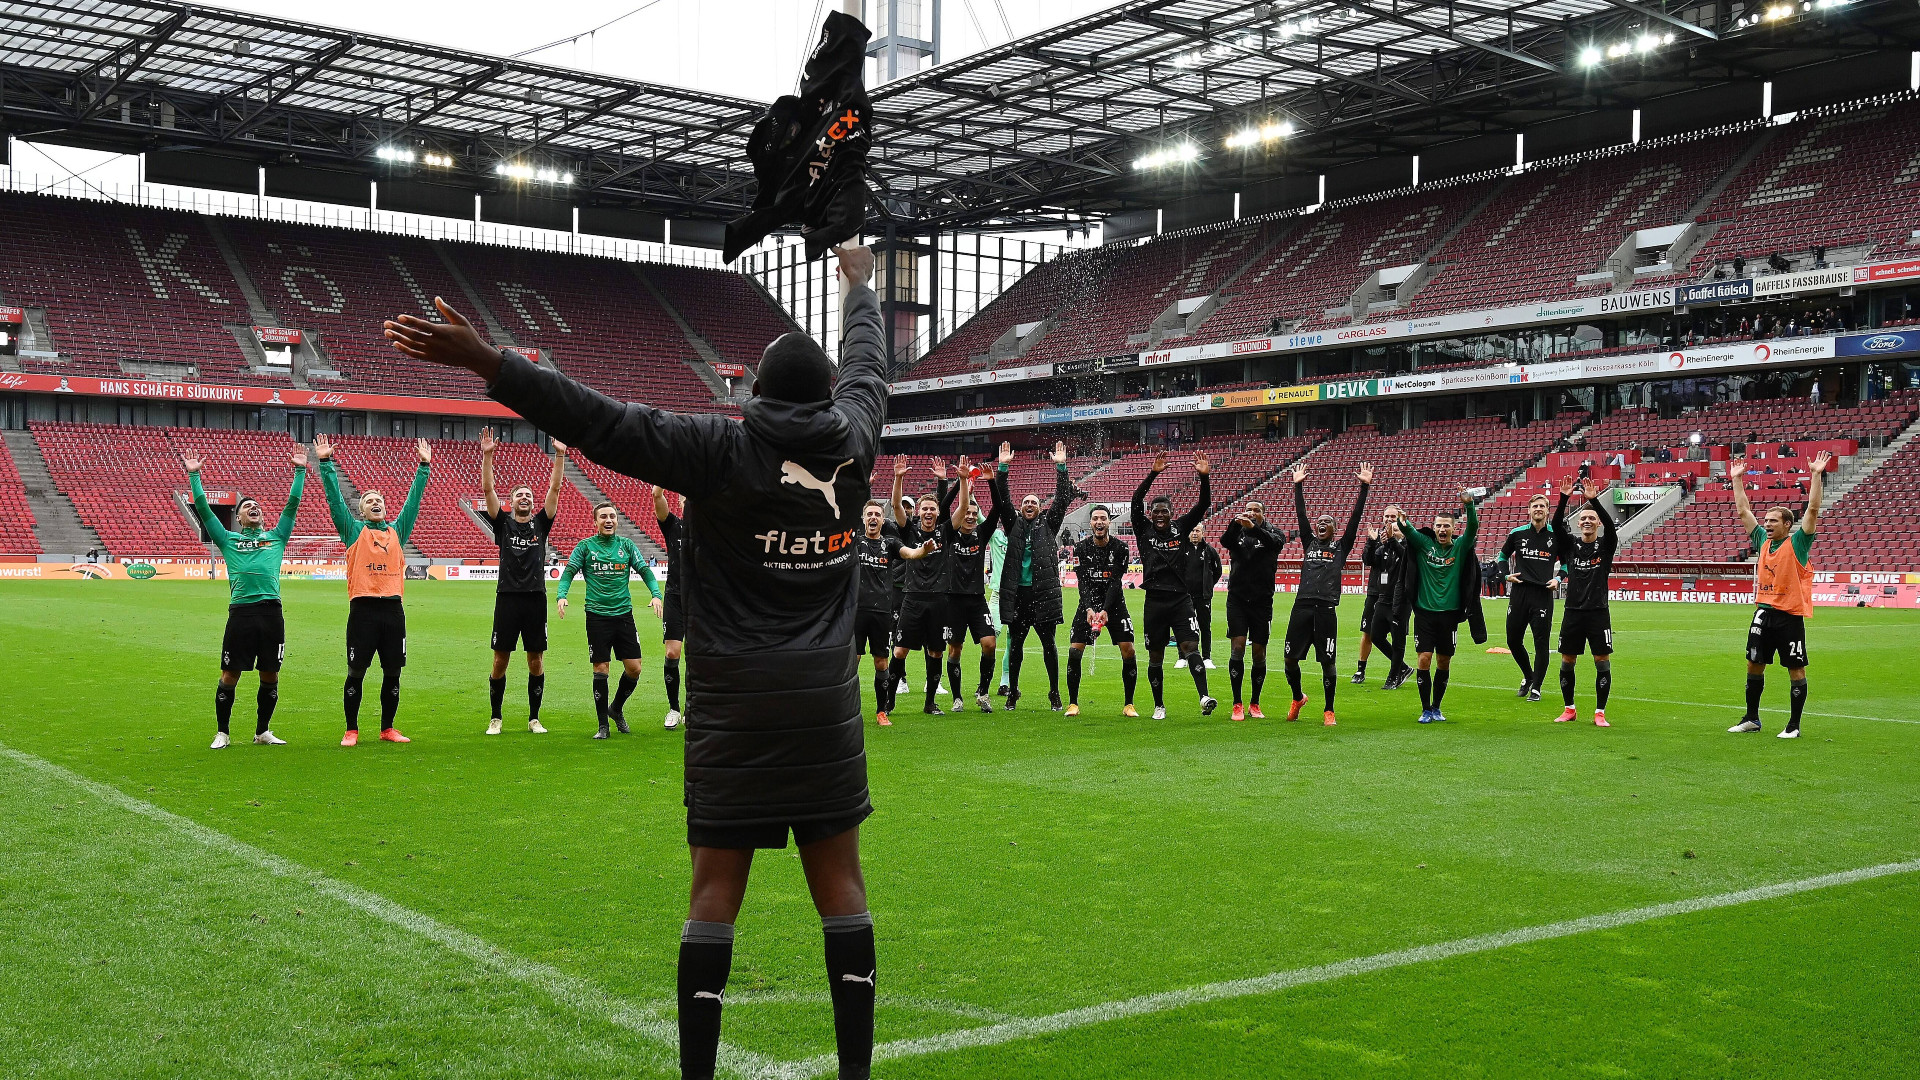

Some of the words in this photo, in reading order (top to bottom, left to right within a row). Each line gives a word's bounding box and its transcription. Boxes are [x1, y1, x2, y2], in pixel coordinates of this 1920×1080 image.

[811, 28, 830, 60] sonepar
[1755, 278, 1790, 292] GAFFELS
[1792, 271, 1848, 288] FASSBRAUSE
[1688, 285, 1716, 300] Gaffel
[1718, 282, 1749, 298] Kölsch
[1601, 290, 1671, 312] BAUWENS
[1337, 327, 1387, 340] CARGLASS
[1233, 340, 1268, 353] REMONDIS
[1289, 334, 1322, 347] stewe
[1870, 337, 1897, 349] Ford
[1773, 345, 1825, 356] RheinEnergie
[1686, 352, 1735, 364] RheinEnergie
[1585, 362, 1637, 373] Kreissparkasse
[1638, 360, 1654, 369] Köln
[1395, 378, 1436, 389] NetCologne
[1441, 373, 1475, 385] Sparkasse
[100, 380, 129, 395] HANS
[133, 381, 184, 398] SCHÄFER
[187, 384, 244, 401] SÜDKURVE
[1278, 389, 1314, 400] RENAULT
[1326, 380, 1369, 399] DEVK
[1073, 407, 1114, 418] SIEGENIA
[1167, 401, 1200, 413] sunzinet
[0, 566, 42, 577] wurst!
[184, 567, 204, 577] Hol
[1342, 585, 1364, 595] REWE
[1608, 590, 1640, 601] REWE
[1644, 590, 1678, 602] REWE
[1681, 591, 1716, 603] REWE
[1720, 592, 1755, 604] REWE
[1812, 593, 1838, 602] EWE
[1325, 637, 1335, 653] 16
[1789, 640, 1803, 656] 24
